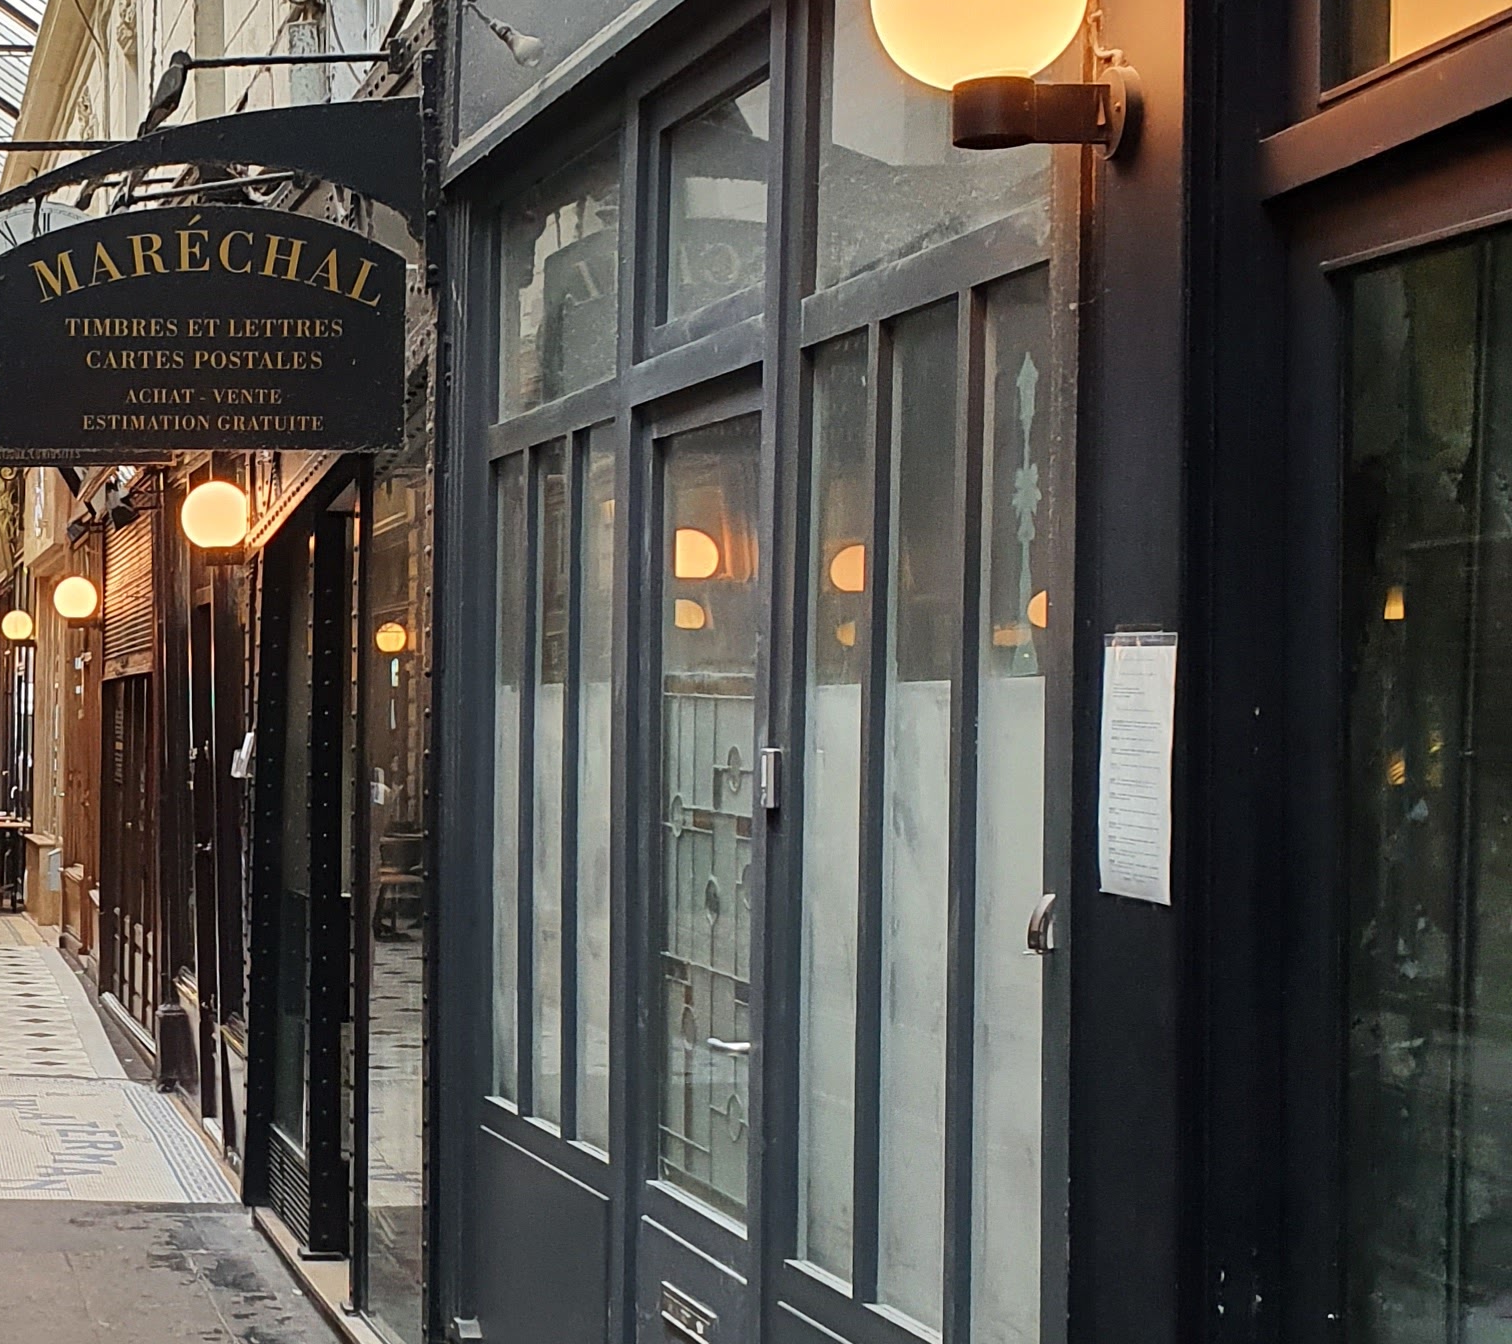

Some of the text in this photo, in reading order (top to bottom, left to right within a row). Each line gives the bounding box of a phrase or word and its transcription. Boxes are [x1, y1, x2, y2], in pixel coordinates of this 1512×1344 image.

[28, 214, 384, 308] MARÉCHAL
[65, 318, 344, 338] TIMBRES ET LETTRES
[86, 349, 324, 371] CARTES POSTALES
[125, 387, 194, 405] ACHAT
[213, 387, 282, 405] VENTE
[82, 414, 324, 433] ESTIMATION GRATUITE
